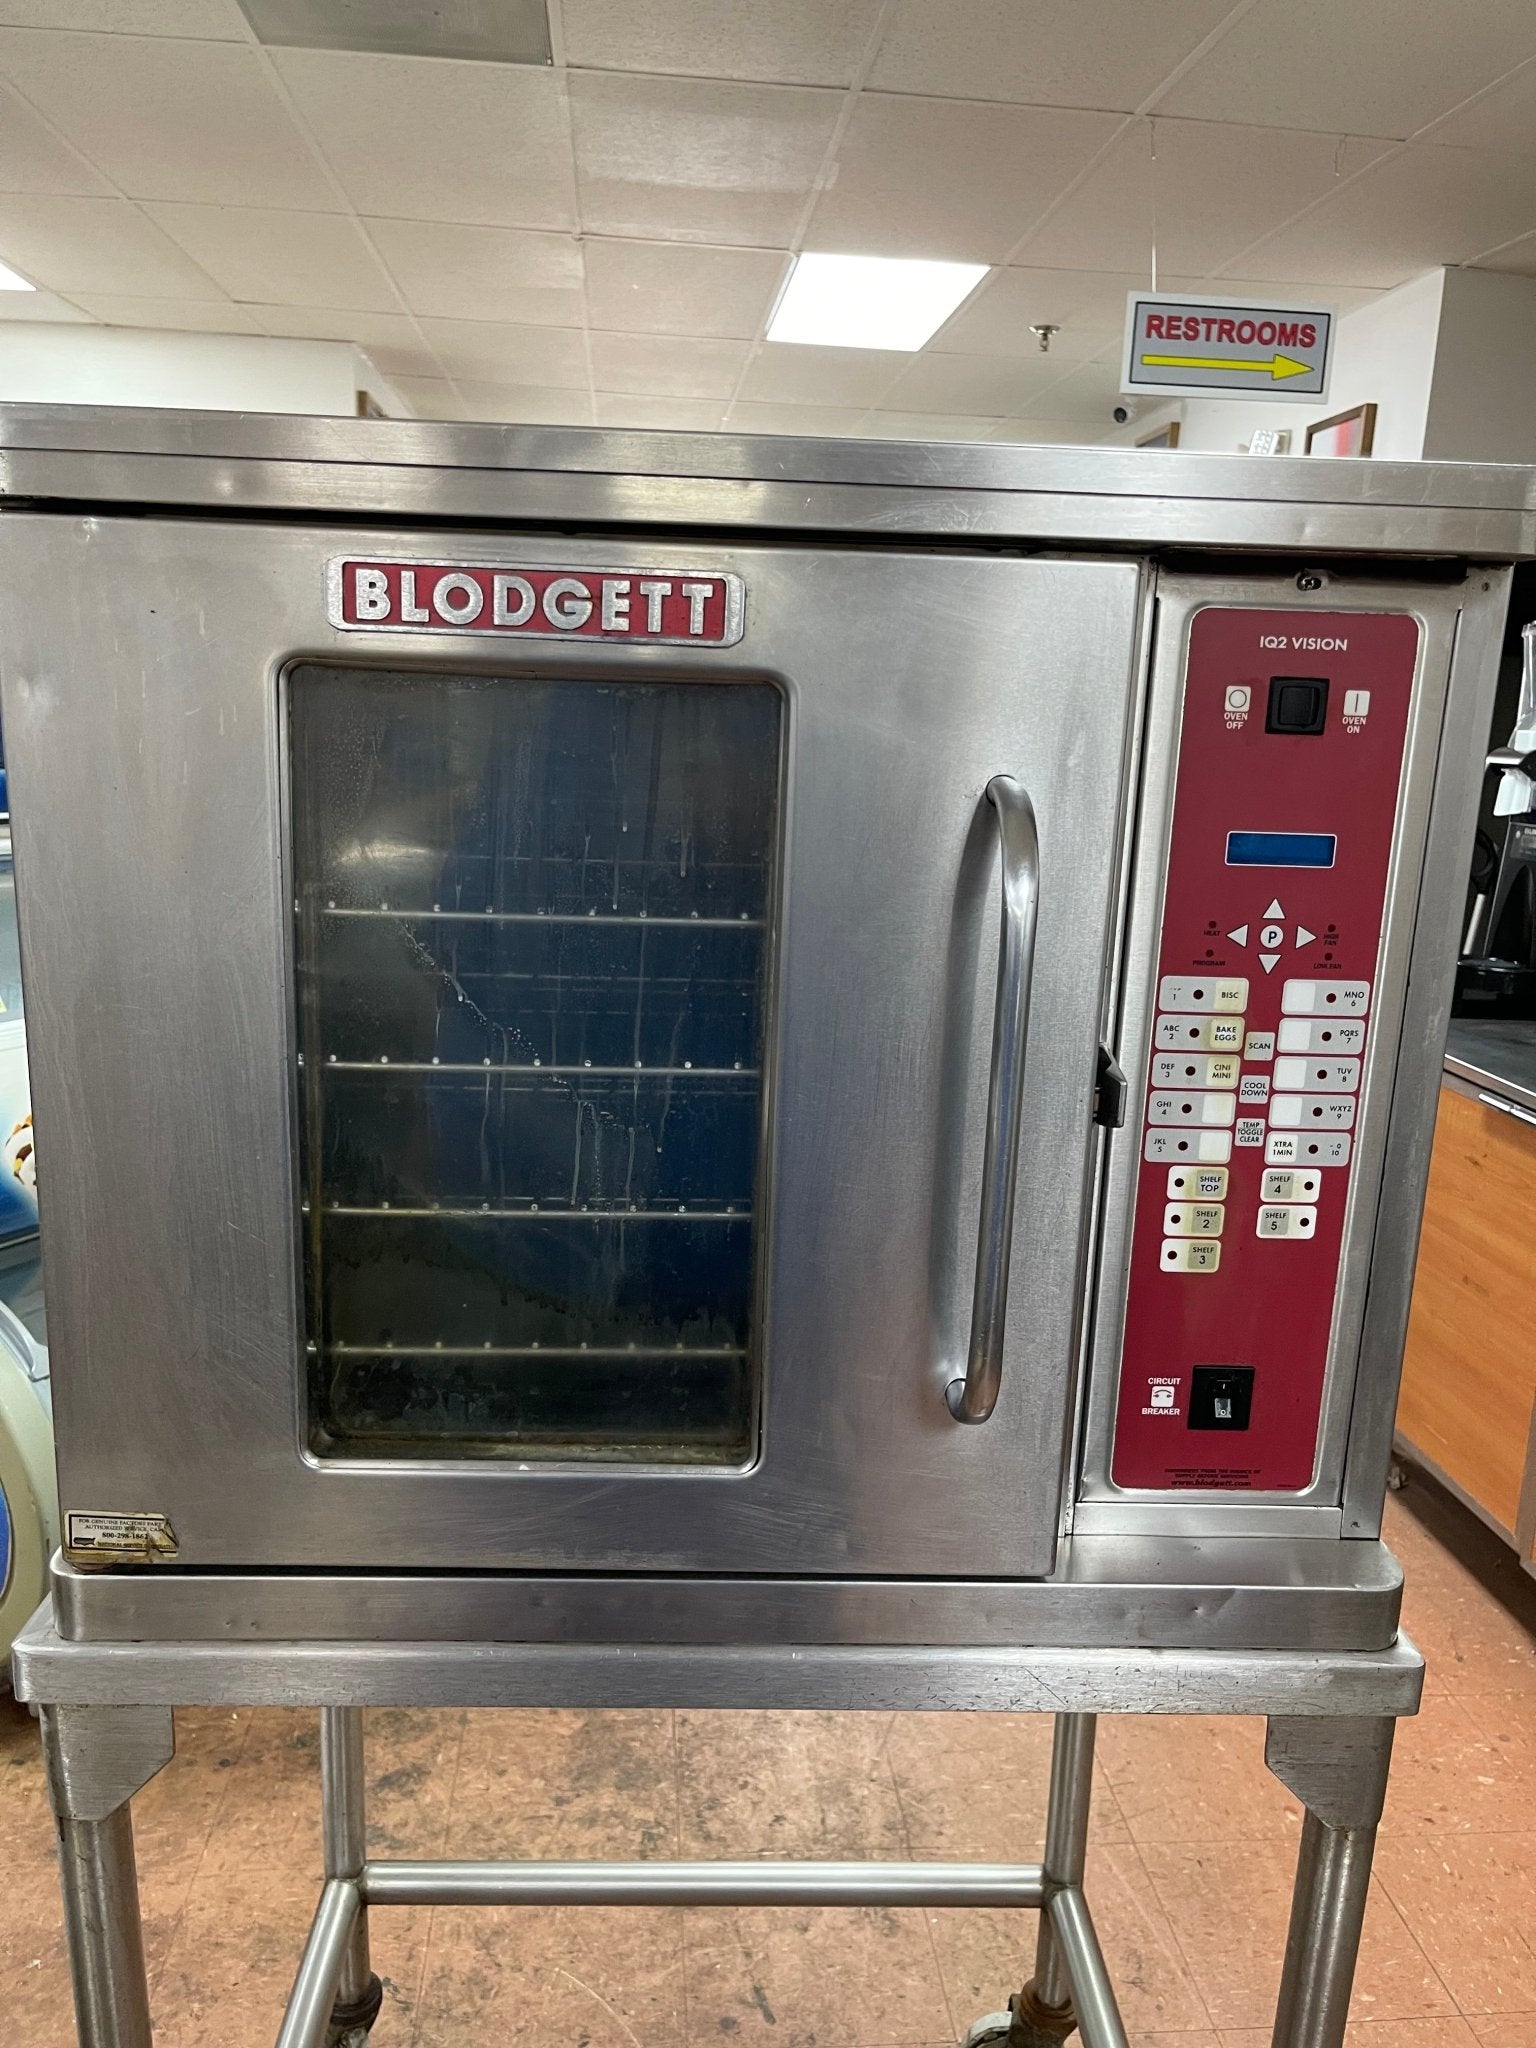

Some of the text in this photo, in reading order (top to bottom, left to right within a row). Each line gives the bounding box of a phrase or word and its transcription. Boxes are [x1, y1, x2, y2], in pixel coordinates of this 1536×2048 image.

[1145, 314, 1316, 348] RESTROOMS
[355, 568, 713, 634] BLODGETT
[1259, 636, 1348, 651] IQ2 VISION
[1224, 712, 1248, 721] OVEN
[1342, 716, 1366, 726] OVEN
[1226, 721, 1244, 730] OFF
[1346, 725, 1360, 734] ON
[1267, 931, 1277, 944] P
[1221, 991, 1239, 999] BISC
[1343, 991, 1365, 999] MNO
[1340, 1029, 1359, 1037] PQRS
[1248, 1042, 1271, 1050] SCAN
[1337, 1067, 1353, 1075] TUV
[1244, 1082, 1267, 1090] COOL
[1241, 1089, 1268, 1097] DOWN
[1156, 1100, 1172, 1108] GHI
[1242, 1121, 1260, 1129] TEMP
[1153, 1138, 1167, 1146] JKL
[1239, 1135, 1260, 1143] CLEAR
[1157, 1146, 1163, 1154] 5
[1269, 1175, 1291, 1183] SHELF
[1201, 1184, 1219, 1193] TOP
[1274, 1185, 1281, 1194] 4
[1196, 1210, 1218, 1218] SHELF
[1202, 1220, 1210, 1229] 2
[1270, 1221, 1278, 1231] 5
[1192, 1246, 1215, 1254] SHELF
[1199, 1255, 1206, 1265] 3
[1148, 1377, 1181, 1385] CIRCUIT
[1142, 1407, 1180, 1416] BREAKER
[1171, 1478, 1252, 1488] www.blodgett.com
